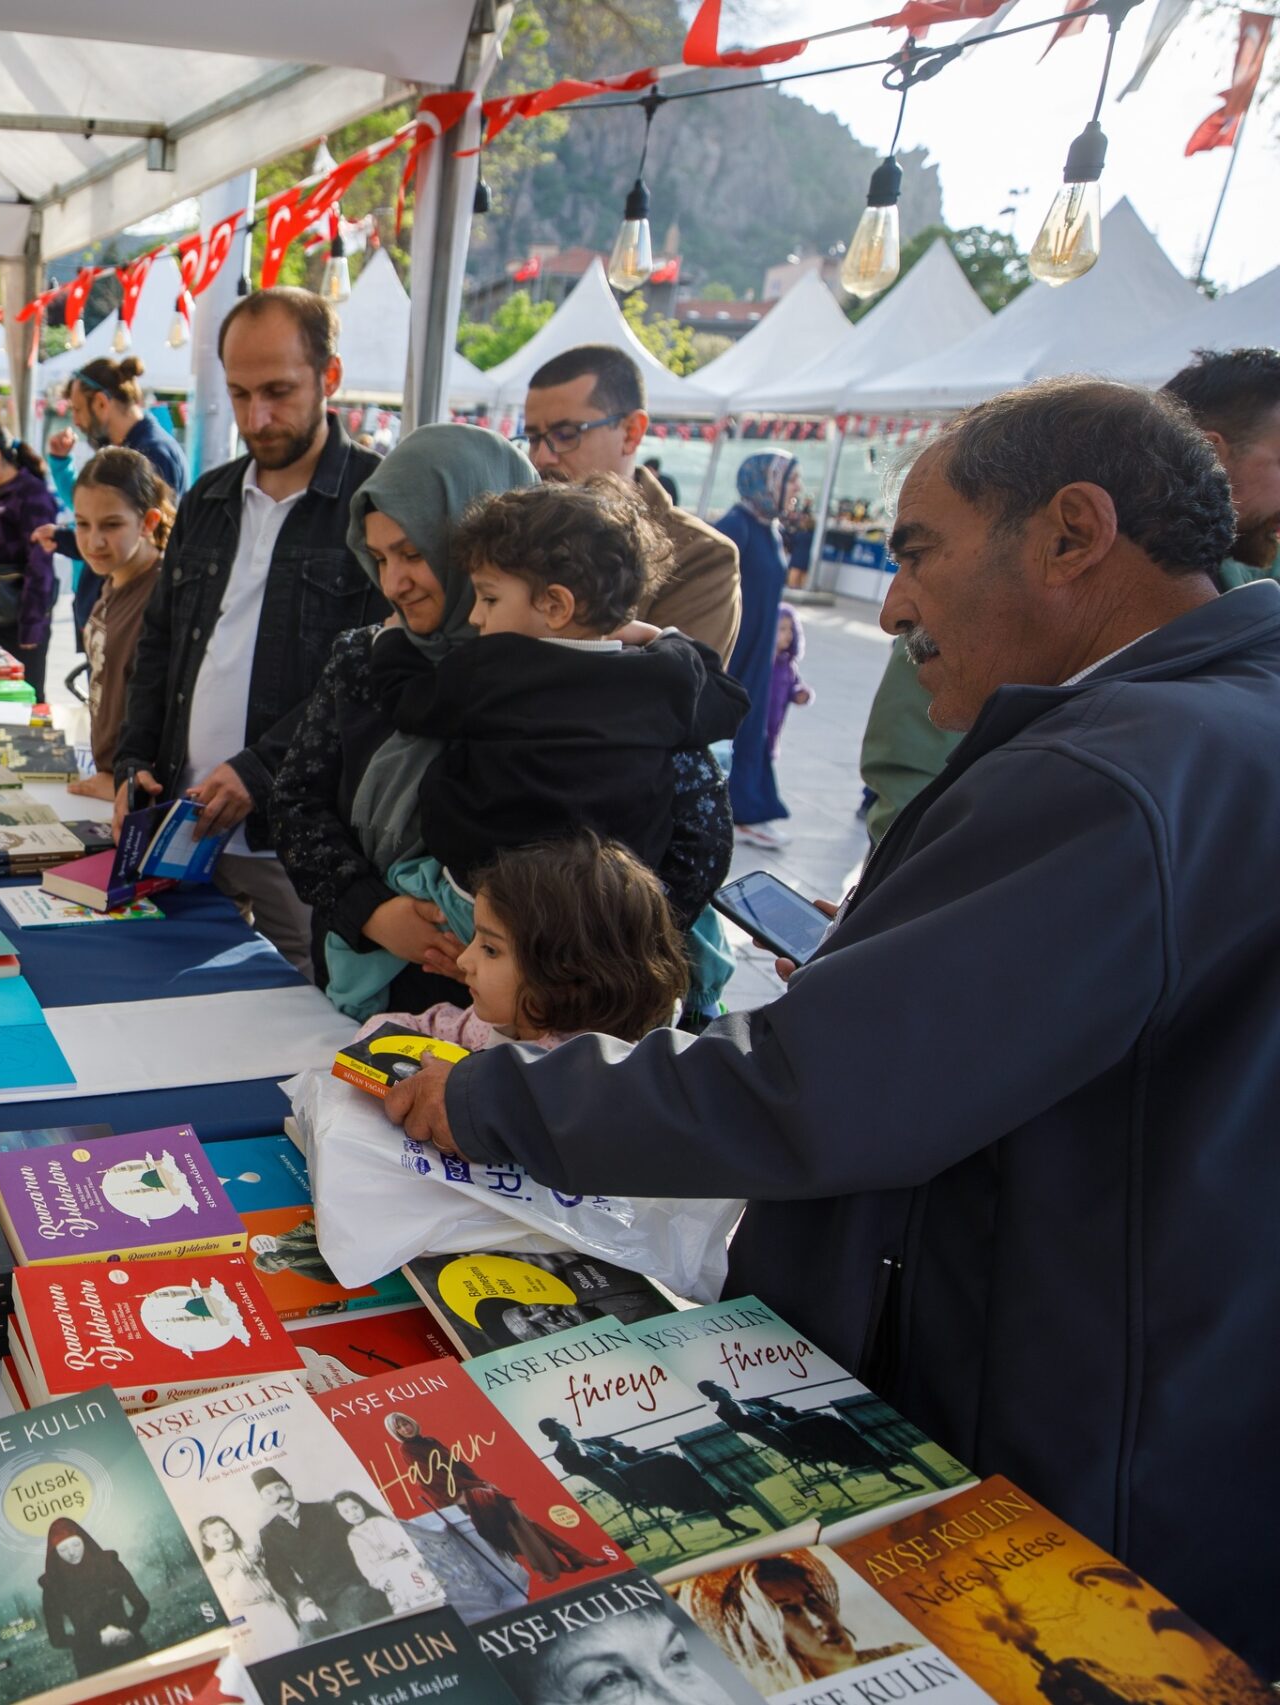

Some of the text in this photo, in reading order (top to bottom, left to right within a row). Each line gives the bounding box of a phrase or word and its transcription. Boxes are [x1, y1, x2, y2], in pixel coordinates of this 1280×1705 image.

[184, 1153, 217, 1208] SİNAN YAĞMUR
[463, 1280, 482, 1298] Bana
[467, 1266, 499, 1296] Güneşimi
[496, 1278, 516, 1295] Getir
[573, 1271, 595, 1290] Sinan
[583, 1264, 610, 1289] Yağmur
[235, 1281, 271, 1340] SİNAN YAĞMUR
[636, 1307, 777, 1350] AYŞE KULİN
[483, 1328, 633, 1391] AYŞE KULİN
[720, 1338, 815, 1389] füreya
[135, 1381, 294, 1441] AYŞE KULİN
[243, 1403, 291, 1424] 1918-1924
[329, 1375, 448, 1423] AYŞE KULİN
[564, 1364, 669, 1427] füreya
[24, 1402, 106, 1443] KULİN
[162, 1413, 286, 1481] Veda
[369, 1431, 496, 1511] Hazan
[12, 1469, 79, 1503] Tutsak
[23, 1491, 85, 1523] Güneş
[865, 1491, 1035, 1586] AYŞE KULİN
[904, 1530, 1067, 1615] Nefes Nefese
[478, 1579, 662, 1659] AYŞE KULİN
[279, 1629, 459, 1705] AYŞE KULİN
[409, 1672, 460, 1698] Kuşlar
[852, 1656, 960, 1696] KULİN
